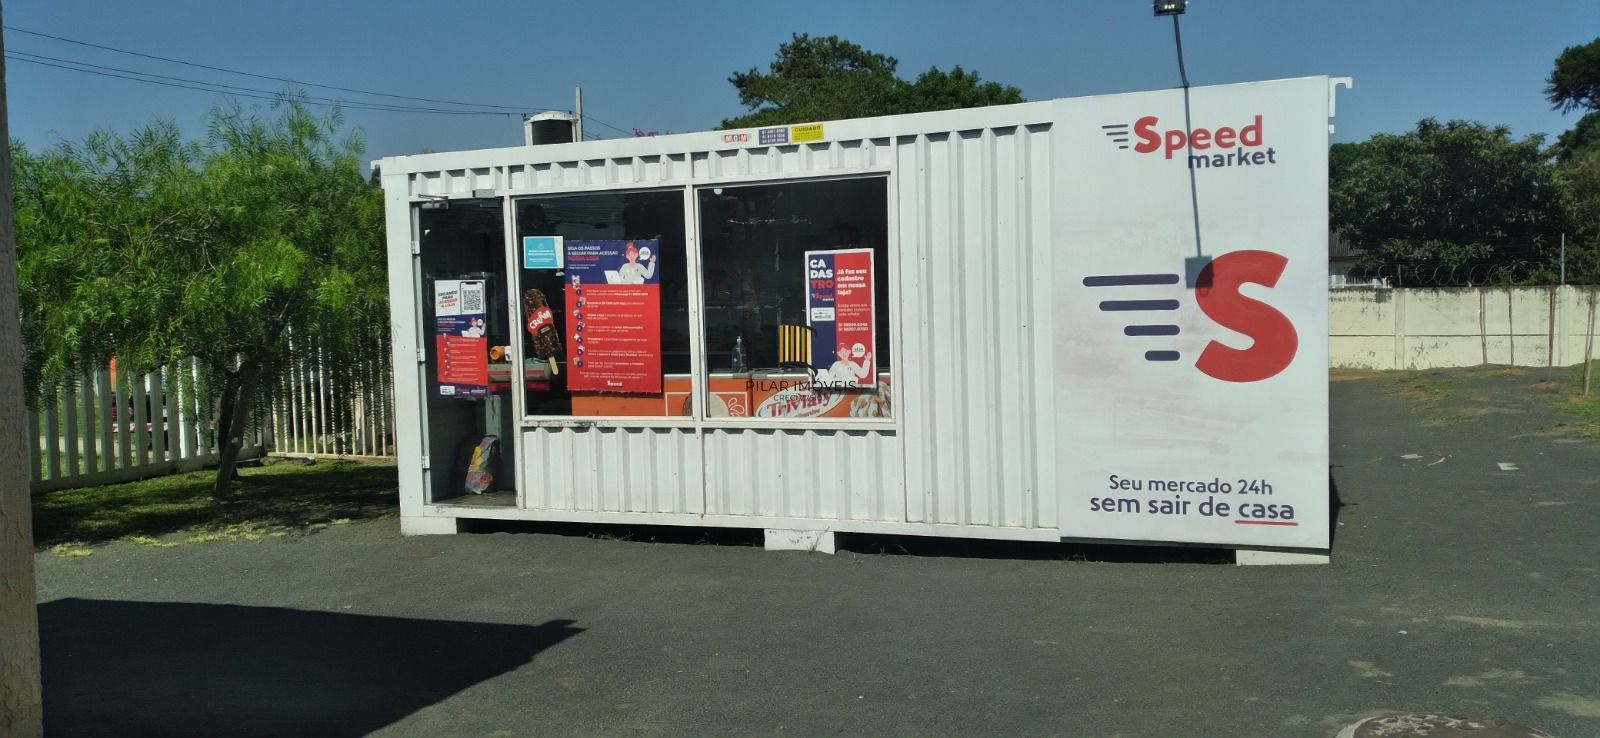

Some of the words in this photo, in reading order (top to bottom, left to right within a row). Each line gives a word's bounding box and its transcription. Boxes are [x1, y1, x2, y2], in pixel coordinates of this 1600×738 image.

[1134, 114, 1263, 160] Speed
[1188, 147, 1276, 169] market
[809, 258, 827, 269] CA
[810, 269, 834, 279] DAS
[811, 279, 834, 289] TRO
[1109, 475, 1142, 490] Seu
[1148, 478, 1232, 494] mercado
[1238, 479, 1273, 495] 24h
[1090, 496, 1141, 513] sem
[1148, 494, 1191, 515] sair
[1199, 496, 1231, 517] de
[1238, 502, 1295, 520] casa
